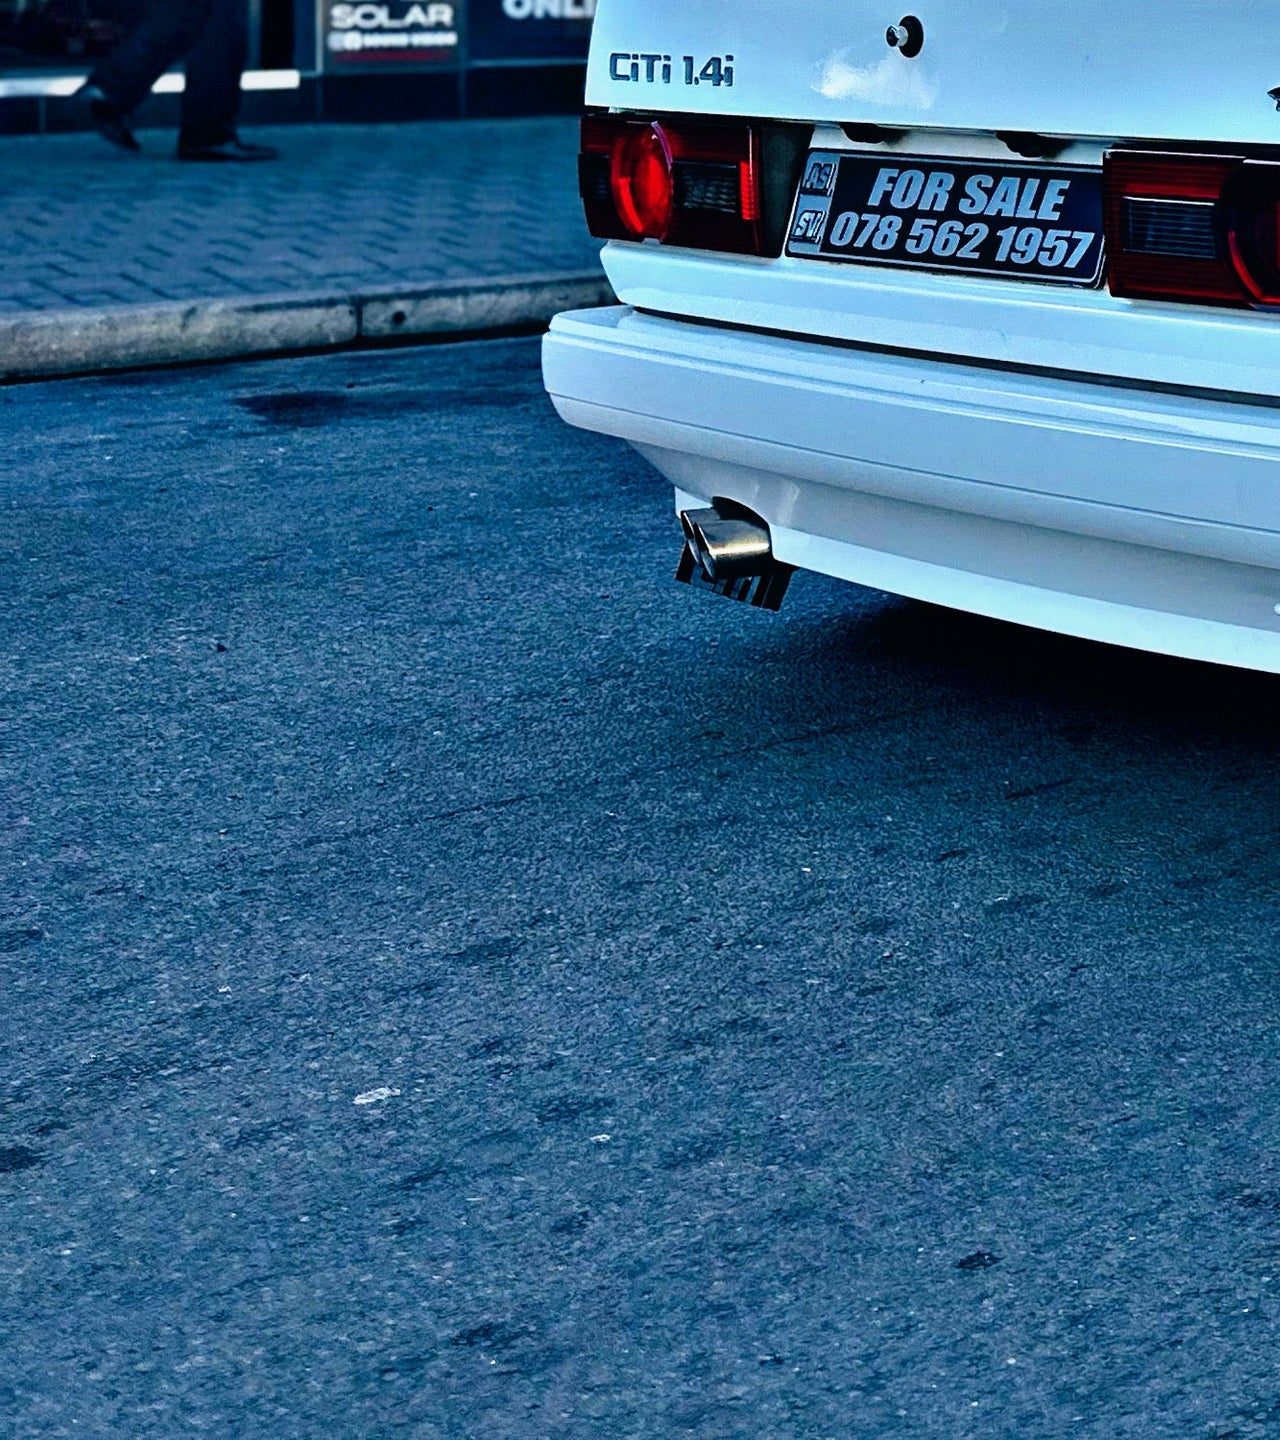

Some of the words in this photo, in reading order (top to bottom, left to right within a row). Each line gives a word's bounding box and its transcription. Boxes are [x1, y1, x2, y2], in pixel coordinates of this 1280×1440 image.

[331, 3, 454, 29] SOLAR
[867, 168, 954, 211] FOR
[958, 174, 1071, 221] SALE
[829, 211, 903, 250] 078
[905, 219, 990, 259] 562
[996, 225, 1096, 268] 1957
